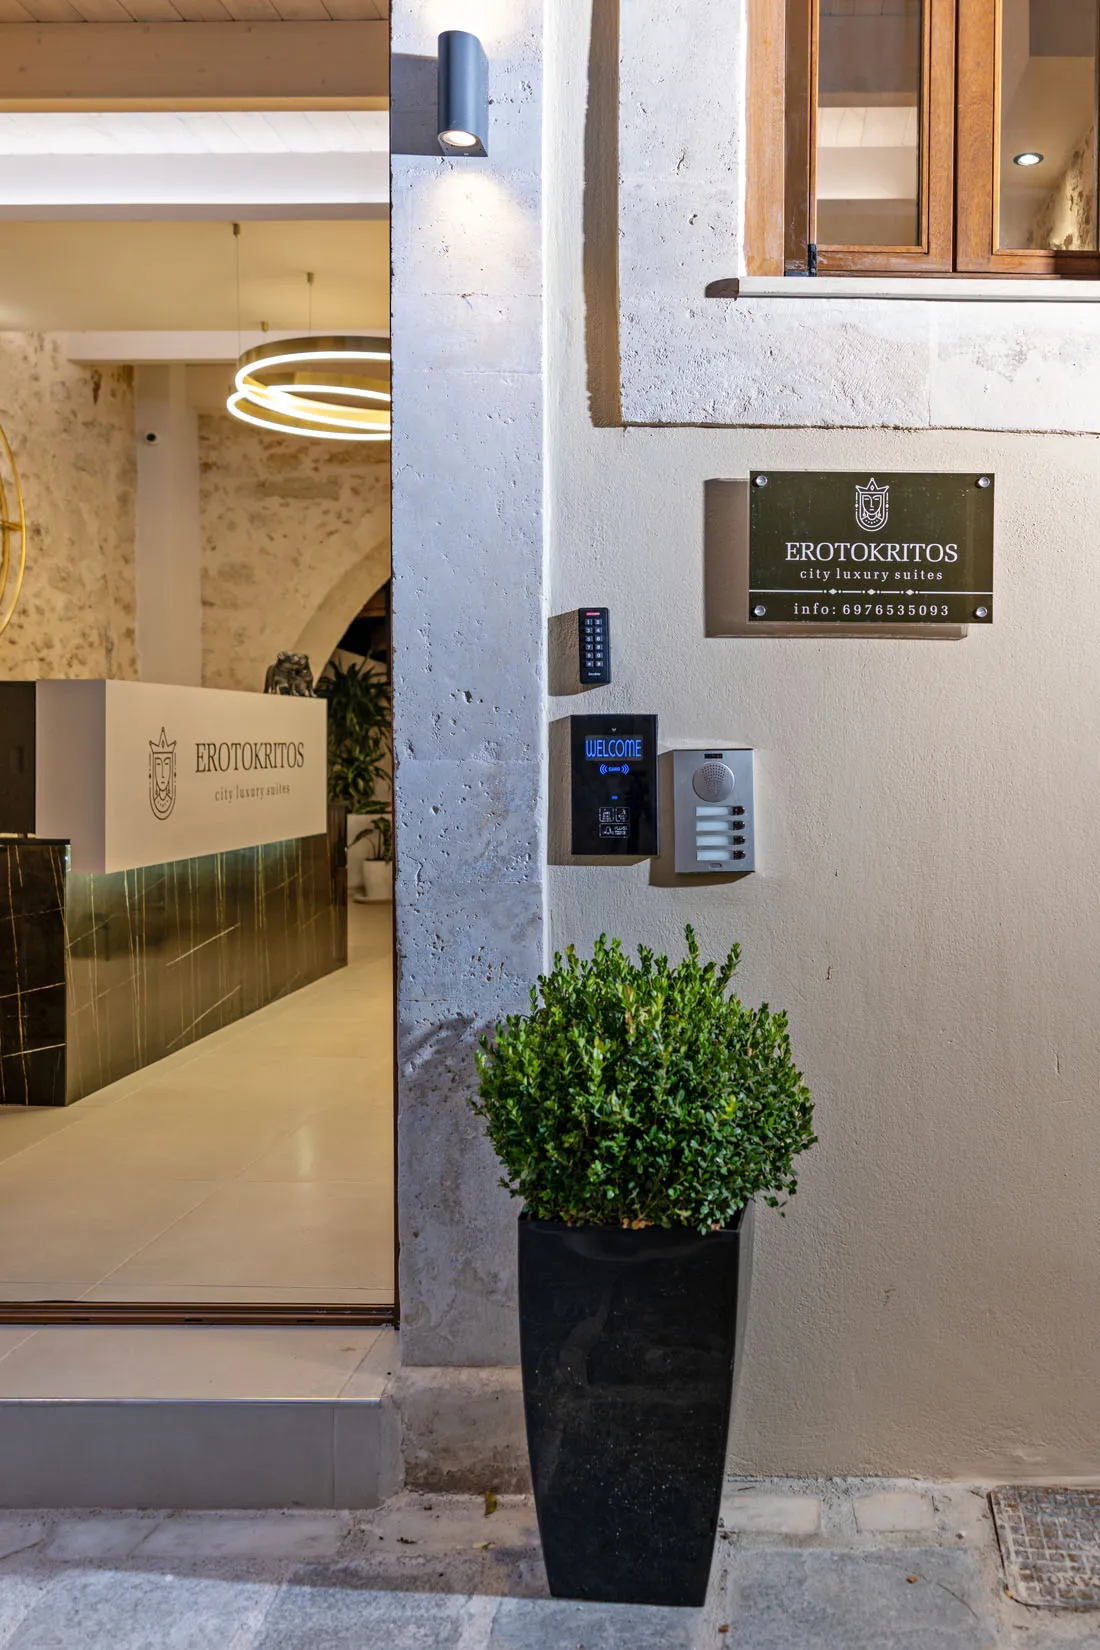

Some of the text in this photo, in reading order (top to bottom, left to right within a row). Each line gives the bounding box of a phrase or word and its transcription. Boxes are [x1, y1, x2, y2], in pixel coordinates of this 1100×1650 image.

[785, 542, 958, 563] EROTOKRITOS
[800, 567, 943, 582] city luxury suites
[793, 603, 949, 616] info: 6976535093
[195, 742, 304, 773] EROTOKRITOS
[585, 739, 642, 757] WELCOME
[215, 783, 290, 803] city luxury suites
